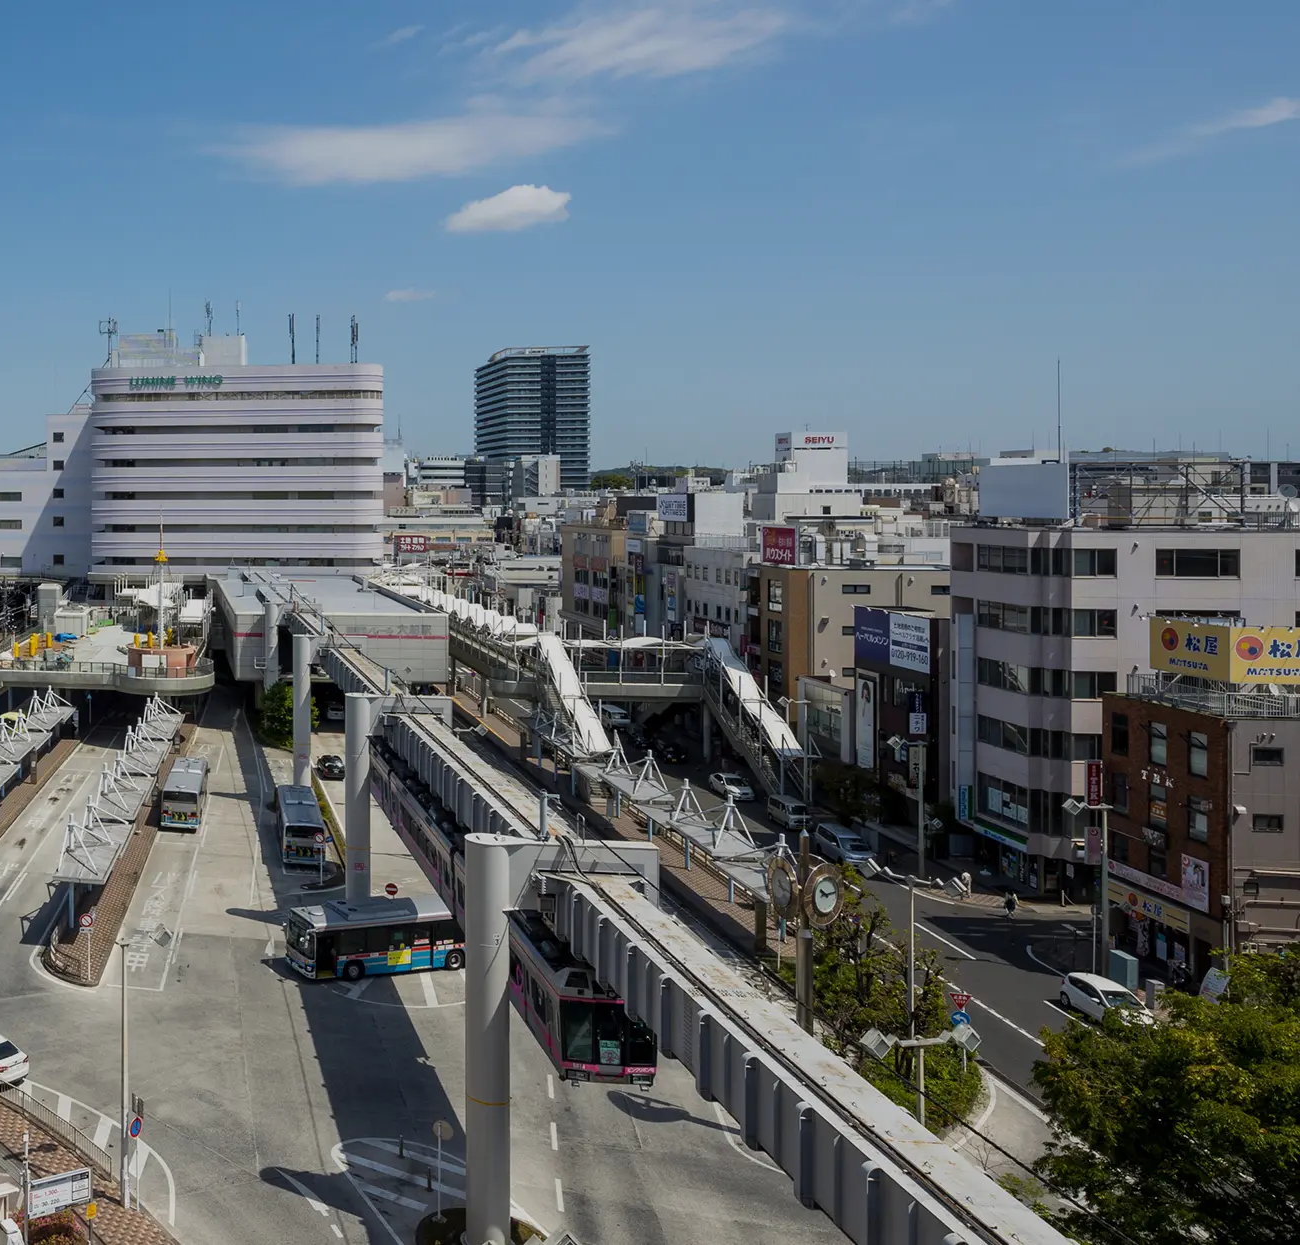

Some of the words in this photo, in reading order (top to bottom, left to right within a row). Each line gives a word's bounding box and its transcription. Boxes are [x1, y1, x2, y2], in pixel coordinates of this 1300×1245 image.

[129, 375, 177, 387] LUMINE
[184, 374, 223, 386] WING
[805, 436, 835, 444] SEIYU
[765, 547, 793, 562] ハウスメイト
[1184, 632, 1218, 656] 松屋
[891, 647, 929, 666] 0120-919-160
[1168, 657, 1209, 671] MATSUYA
[1090, 776, 1098, 801] TBK
[1140, 769, 1175, 789] TBK
[1142, 899, 1163, 918] 松屋
